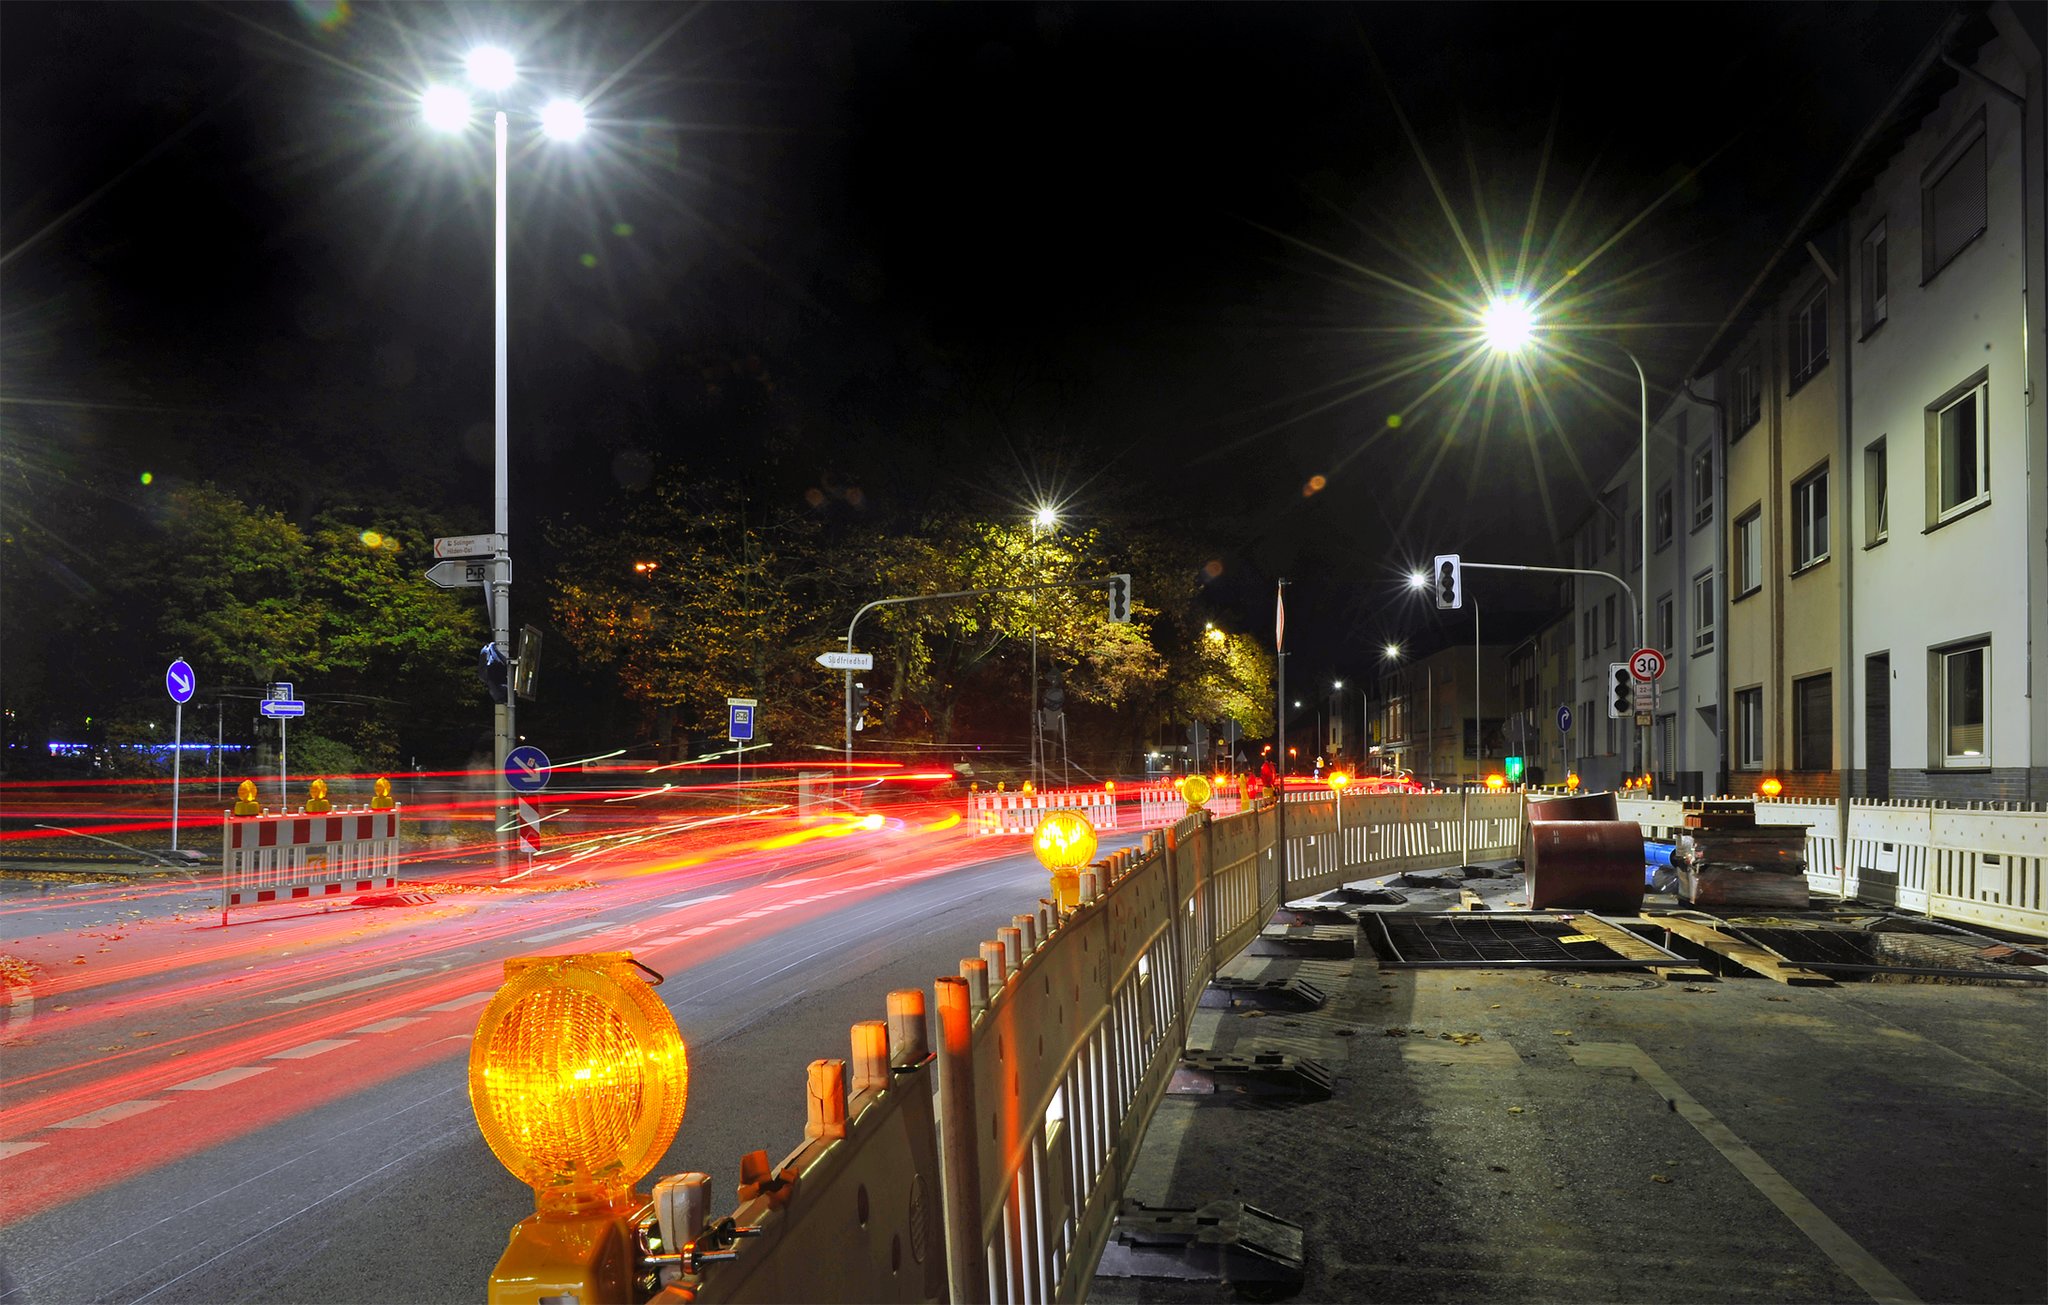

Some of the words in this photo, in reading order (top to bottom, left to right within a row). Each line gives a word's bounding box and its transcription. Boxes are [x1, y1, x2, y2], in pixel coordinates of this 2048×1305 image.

[465, 567, 486, 579] P+R
[828, 655, 868, 665] Südfriedhof
[1637, 658, 1657, 673] 30
